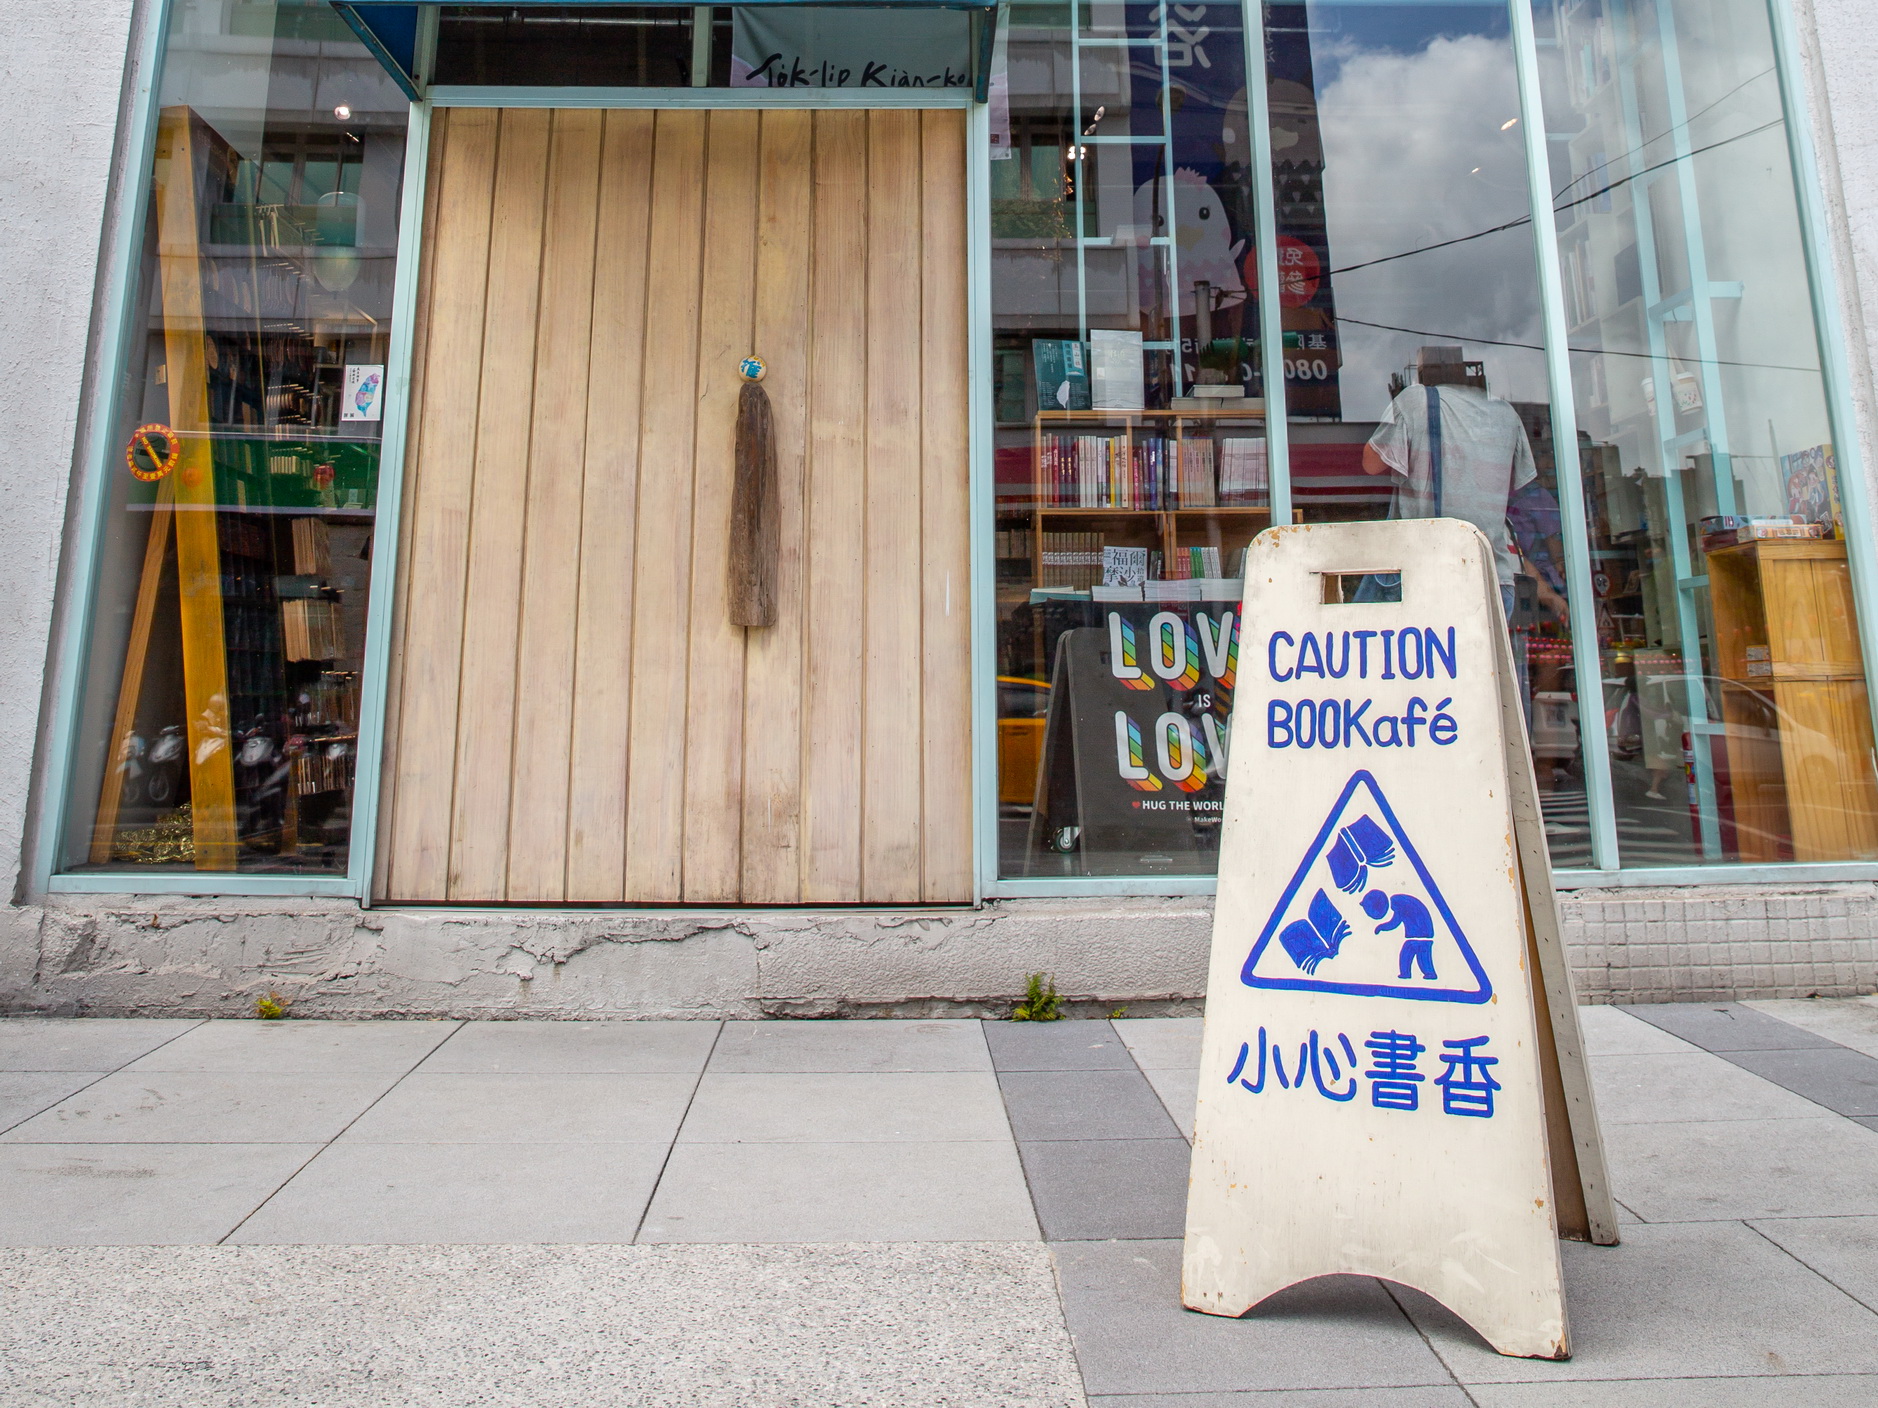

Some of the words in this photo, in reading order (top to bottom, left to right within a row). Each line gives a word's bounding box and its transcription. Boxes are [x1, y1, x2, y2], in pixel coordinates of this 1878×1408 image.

[861, 61, 973, 87] Kiàn-ko
[1108, 611, 1238, 690] LOV
[1268, 627, 1458, 683] CAUTION
[1198, 694, 1211, 708] IS
[1267, 697, 1458, 750] BOOKafé
[1114, 710, 1232, 791] LOV
[1142, 800, 1167, 810] HUG
[1169, 800, 1191, 811] THE
[1193, 801, 1225, 811] WORL
[1194, 816, 1222, 824] MakeWo
[1226, 1026, 1502, 1119] 小心書香
